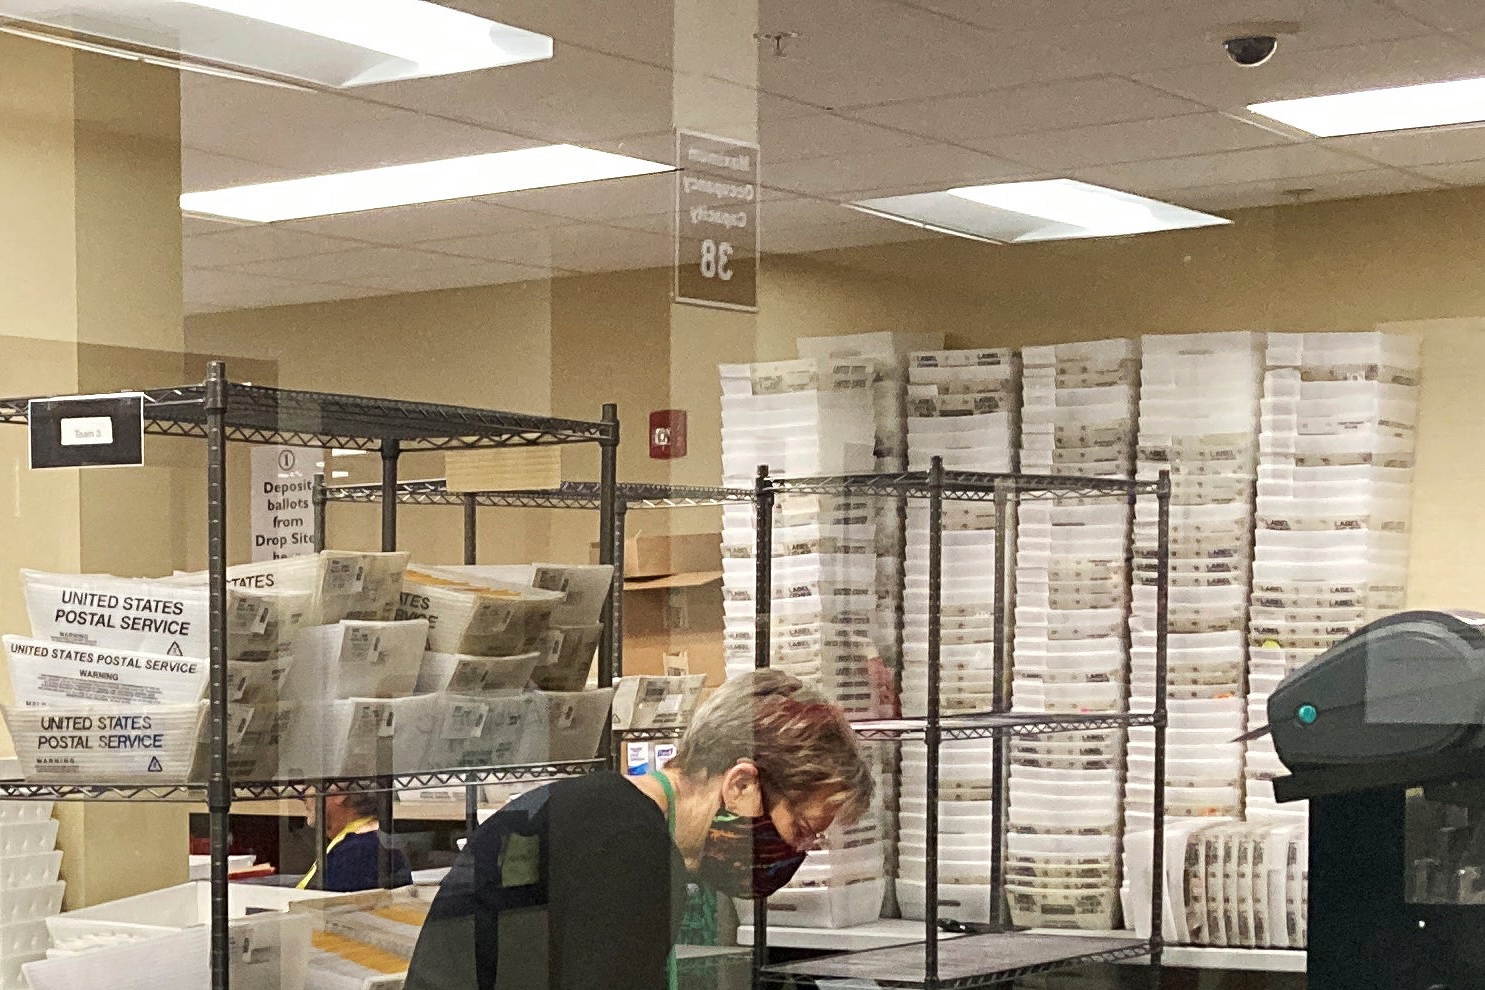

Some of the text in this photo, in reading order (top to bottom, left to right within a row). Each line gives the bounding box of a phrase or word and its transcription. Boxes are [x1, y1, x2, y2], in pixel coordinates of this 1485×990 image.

[264, 480, 313, 496] Deposit
[267, 498, 309, 511] ballots
[273, 516, 304, 528] from
[255, 534, 288, 549] Drop
[226, 573, 275, 588] TATES
[61, 590, 184, 615] UNITED STATES
[55, 609, 191, 636] POSTAL SERVICE
[10, 643, 198, 674] UNITED STATES POSTAL SERVICE
[79, 669, 119, 681] WARNING
[41, 715, 152, 730] UNITED STATES
[37, 734, 164, 749] POSTAL SERVICE
